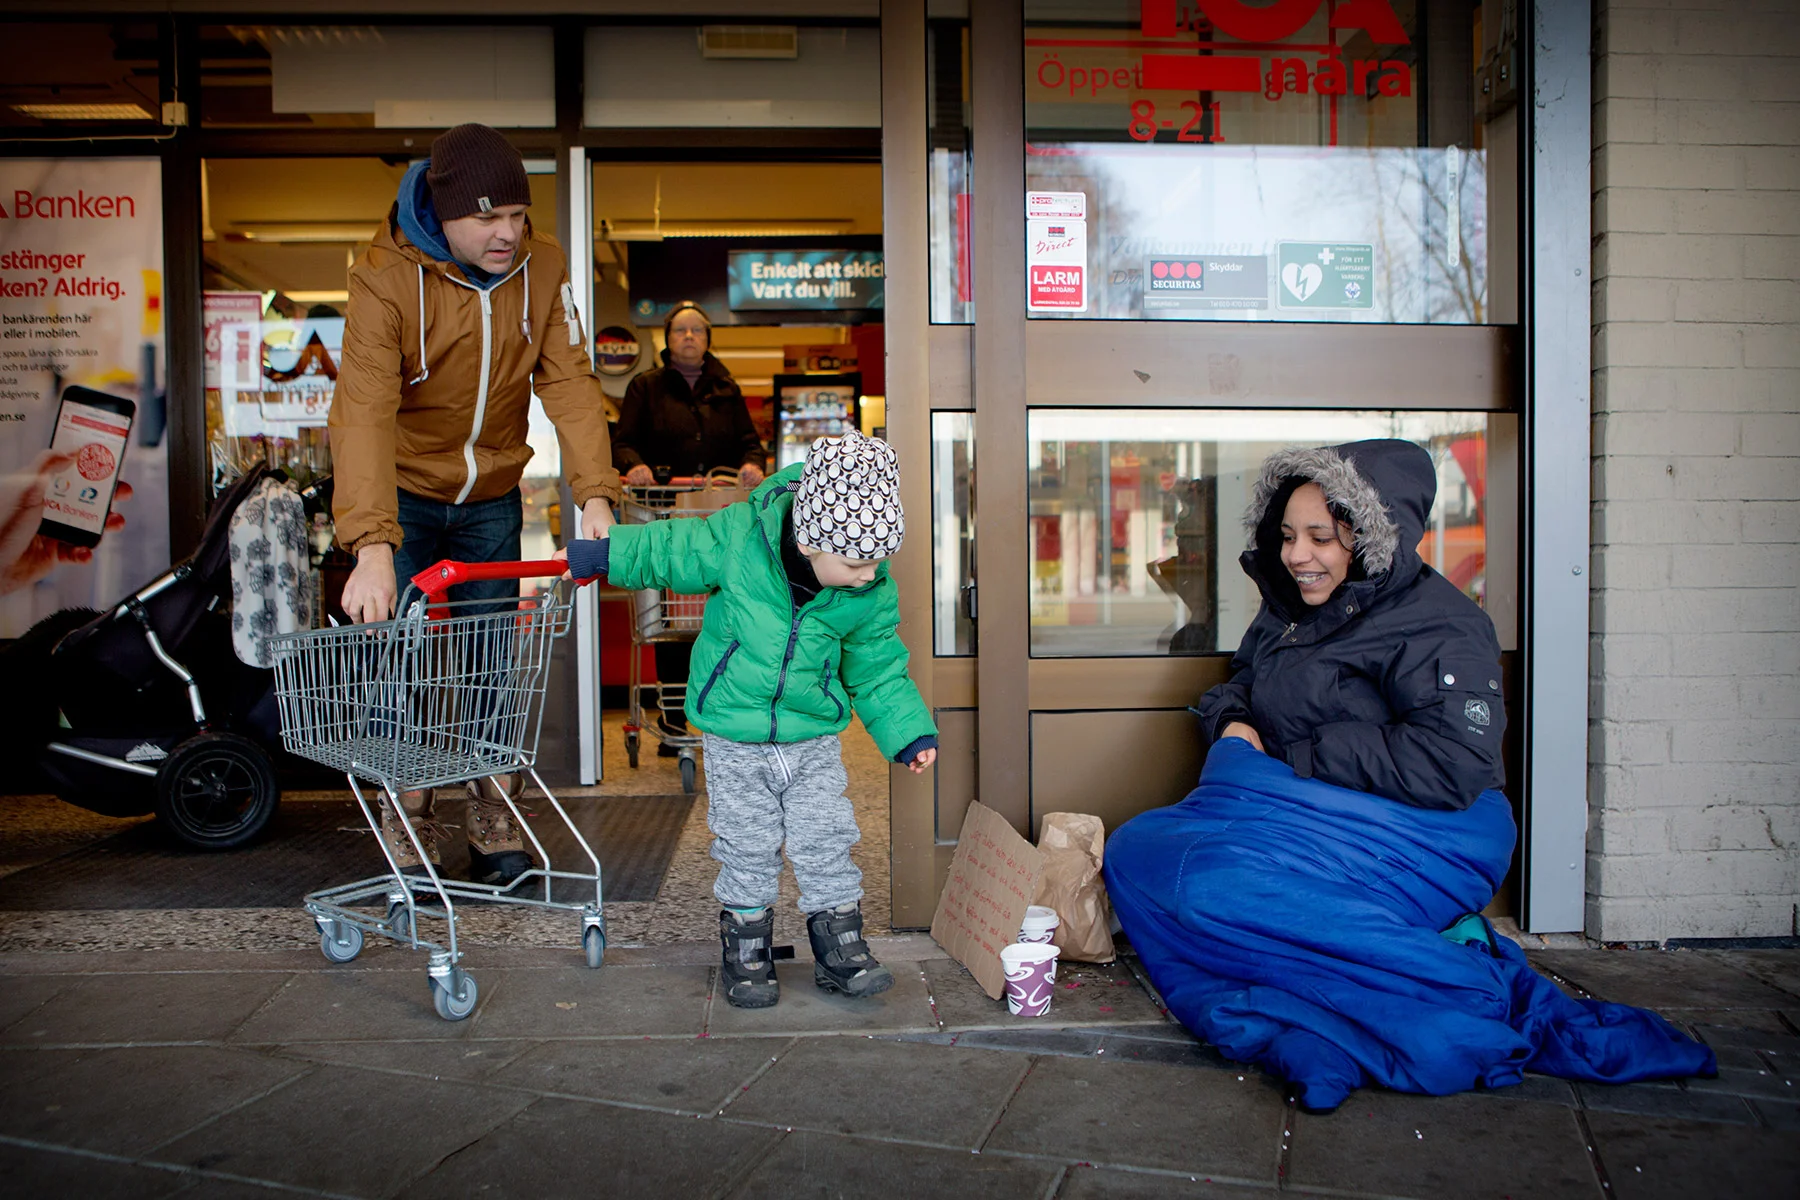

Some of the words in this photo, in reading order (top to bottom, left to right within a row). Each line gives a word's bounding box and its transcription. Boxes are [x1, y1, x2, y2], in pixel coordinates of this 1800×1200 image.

[1037, 53, 1143, 97] Öppet
[1127, 100, 1226, 143] 8-21
[14, 190, 135, 219] Banken
[1, 249, 86, 274] stänger
[751, 261, 812, 279] Enkelt
[813, 261, 841, 278] att
[1209, 262, 1243, 273] Skyddar
[1033, 271, 1080, 286] LARM
[1153, 280, 1202, 289] SECURITAS
[54, 277, 126, 300] Aldrig.
[752, 282, 793, 298] Vart
[795, 281, 820, 298] du
[821, 281, 856, 298] vill.
[3, 313, 73, 325] bankärenden
[75, 313, 93, 323] här
[4, 328, 27, 339] eller
[29, 328, 33, 338] i
[35, 328, 81, 339] mobilen.
